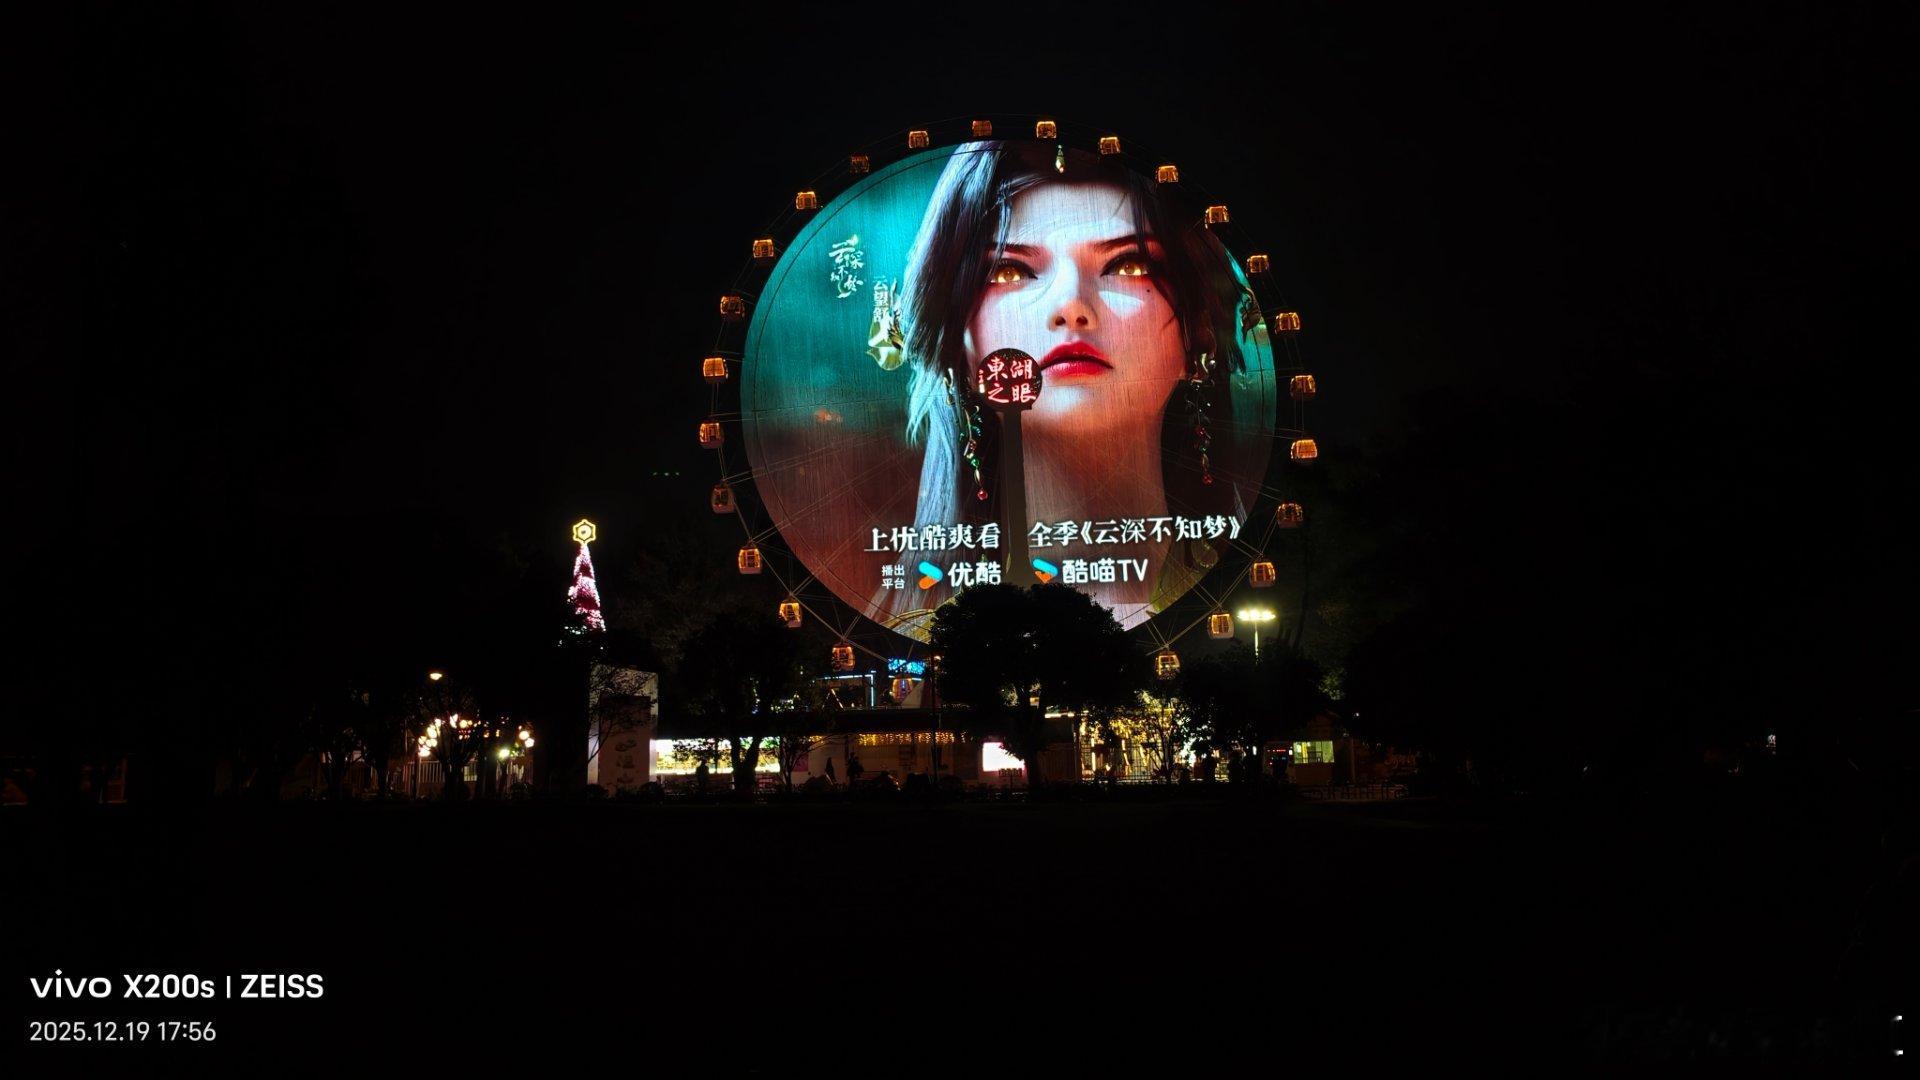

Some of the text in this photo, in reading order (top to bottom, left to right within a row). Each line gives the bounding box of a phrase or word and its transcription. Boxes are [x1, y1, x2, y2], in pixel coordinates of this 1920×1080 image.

[864, 515, 1241, 552] 上优酷爽看 全季《云深不知梦》
[881, 564, 905, 577] 播出
[948, 561, 1002, 587] 优酷
[1062, 557, 1149, 584] 酷喵TV
[881, 578, 905, 590] 平台
